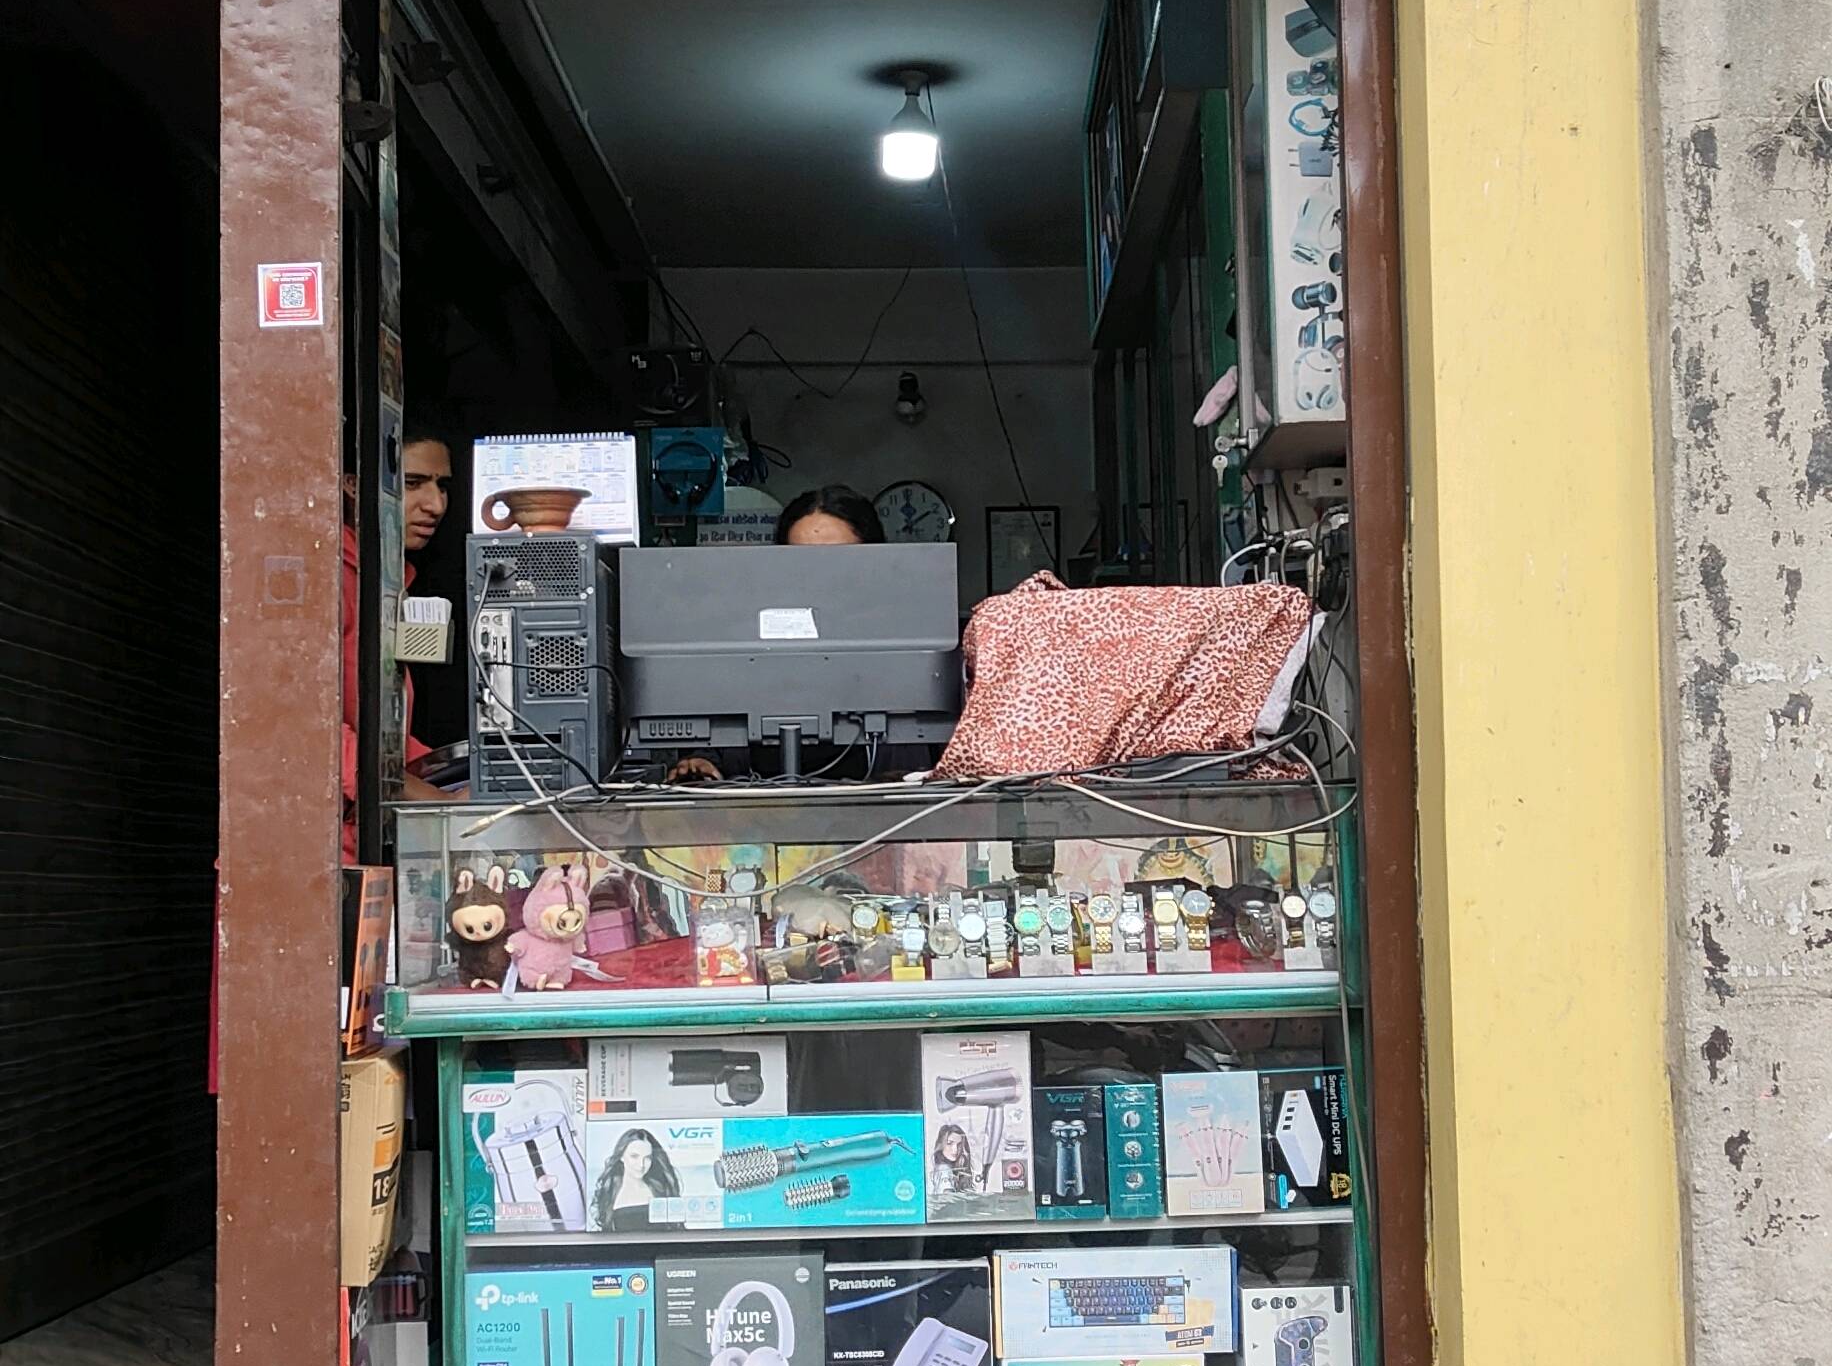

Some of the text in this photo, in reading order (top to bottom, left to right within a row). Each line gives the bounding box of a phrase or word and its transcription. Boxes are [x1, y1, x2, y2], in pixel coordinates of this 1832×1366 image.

[931, 503, 940, 514] 2
[936, 517, 945, 530] 3
[1046, 1091, 1087, 1104] VGR
[1328, 1074, 1342, 1156] Smart Mini DC UPS
[668, 1126, 717, 1139] VGR
[728, 1212, 753, 1223] 2in1
[828, 1276, 897, 1291] Panasonic
[501, 1291, 539, 1306] tp-link
[705, 1308, 772, 1325] HTune
[476, 1322, 521, 1333] AC1200
